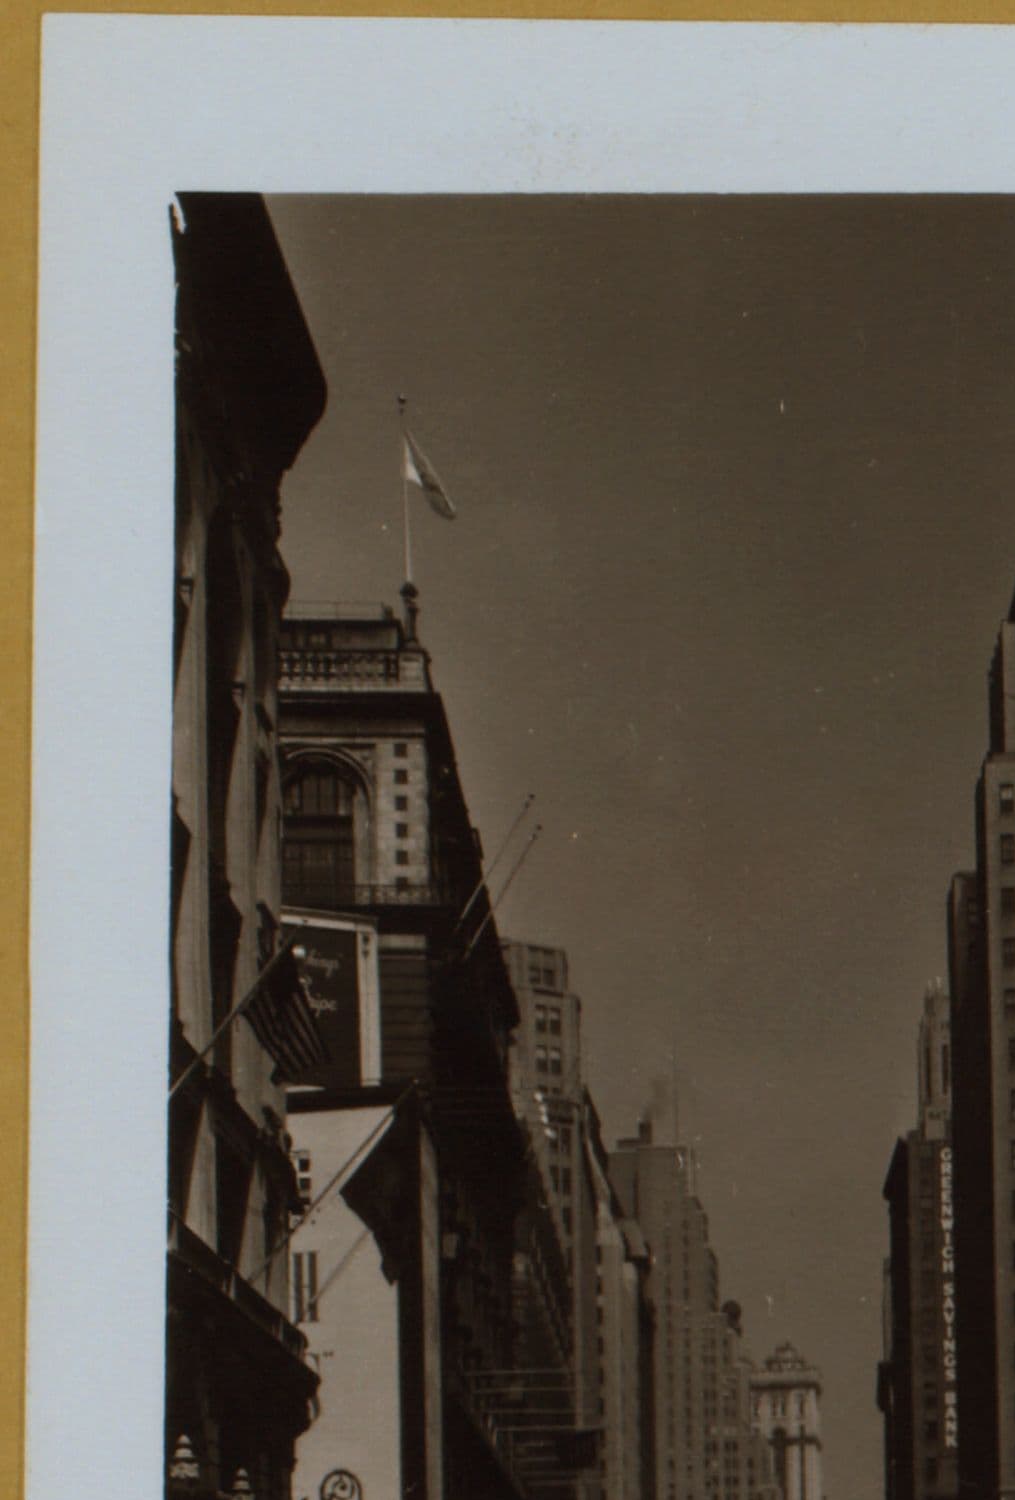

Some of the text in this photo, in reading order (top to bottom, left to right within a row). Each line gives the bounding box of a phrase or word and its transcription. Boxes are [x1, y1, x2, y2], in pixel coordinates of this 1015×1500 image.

[940, 1146, 958, 1449] GREENWICH SAVINGS BANK
